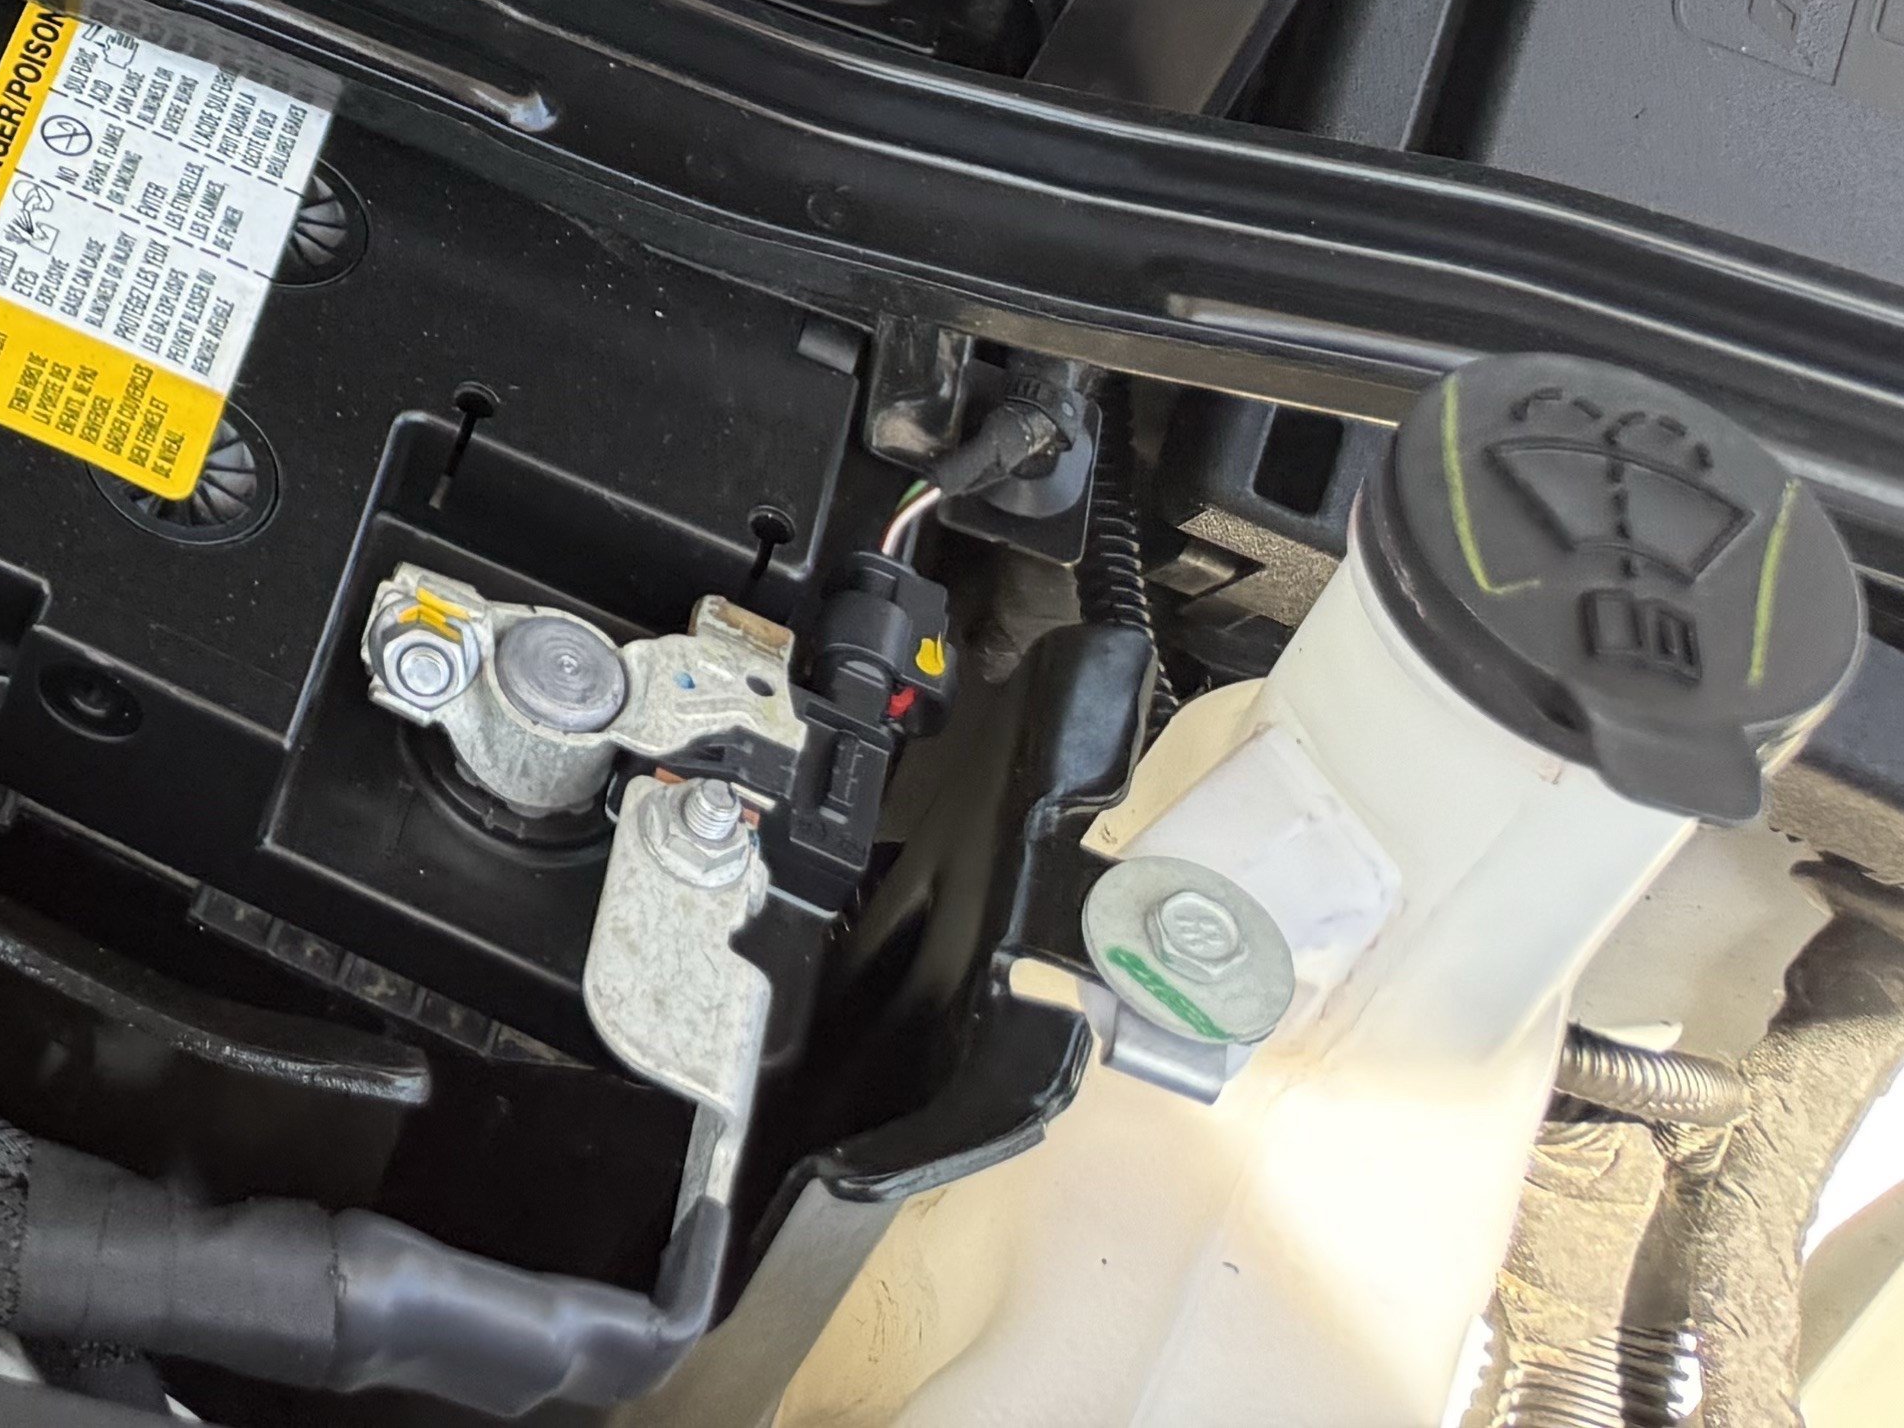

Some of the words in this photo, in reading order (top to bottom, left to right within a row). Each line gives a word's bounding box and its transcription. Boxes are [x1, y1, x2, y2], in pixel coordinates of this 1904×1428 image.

[63, 47, 98, 94] SULFURIC
[87, 79, 113, 105] ACID
[119, 68, 145, 98] CAUSE
[112, 94, 134, 114] CAN
[237, 91, 256, 106] LA
[255, 108, 278, 129] DES
[96, 123, 125, 159] FLAMES
[55, 165, 79, 185] NO
[112, 150, 142, 191] SMOKING
[163, 210, 185, 231] LES
[187, 220, 210, 241] LES
[79, 236, 106, 269] CAUSE
[142, 238, 169, 269] YEUX
[212, 234, 232, 252] DE
[10, 266, 39, 297] EYES
[34, 256, 69, 306] EXPLOSIVE
[71, 267, 93, 287] CAN
[133, 266, 159, 290] LES
[141, 332, 163, 354] LES
